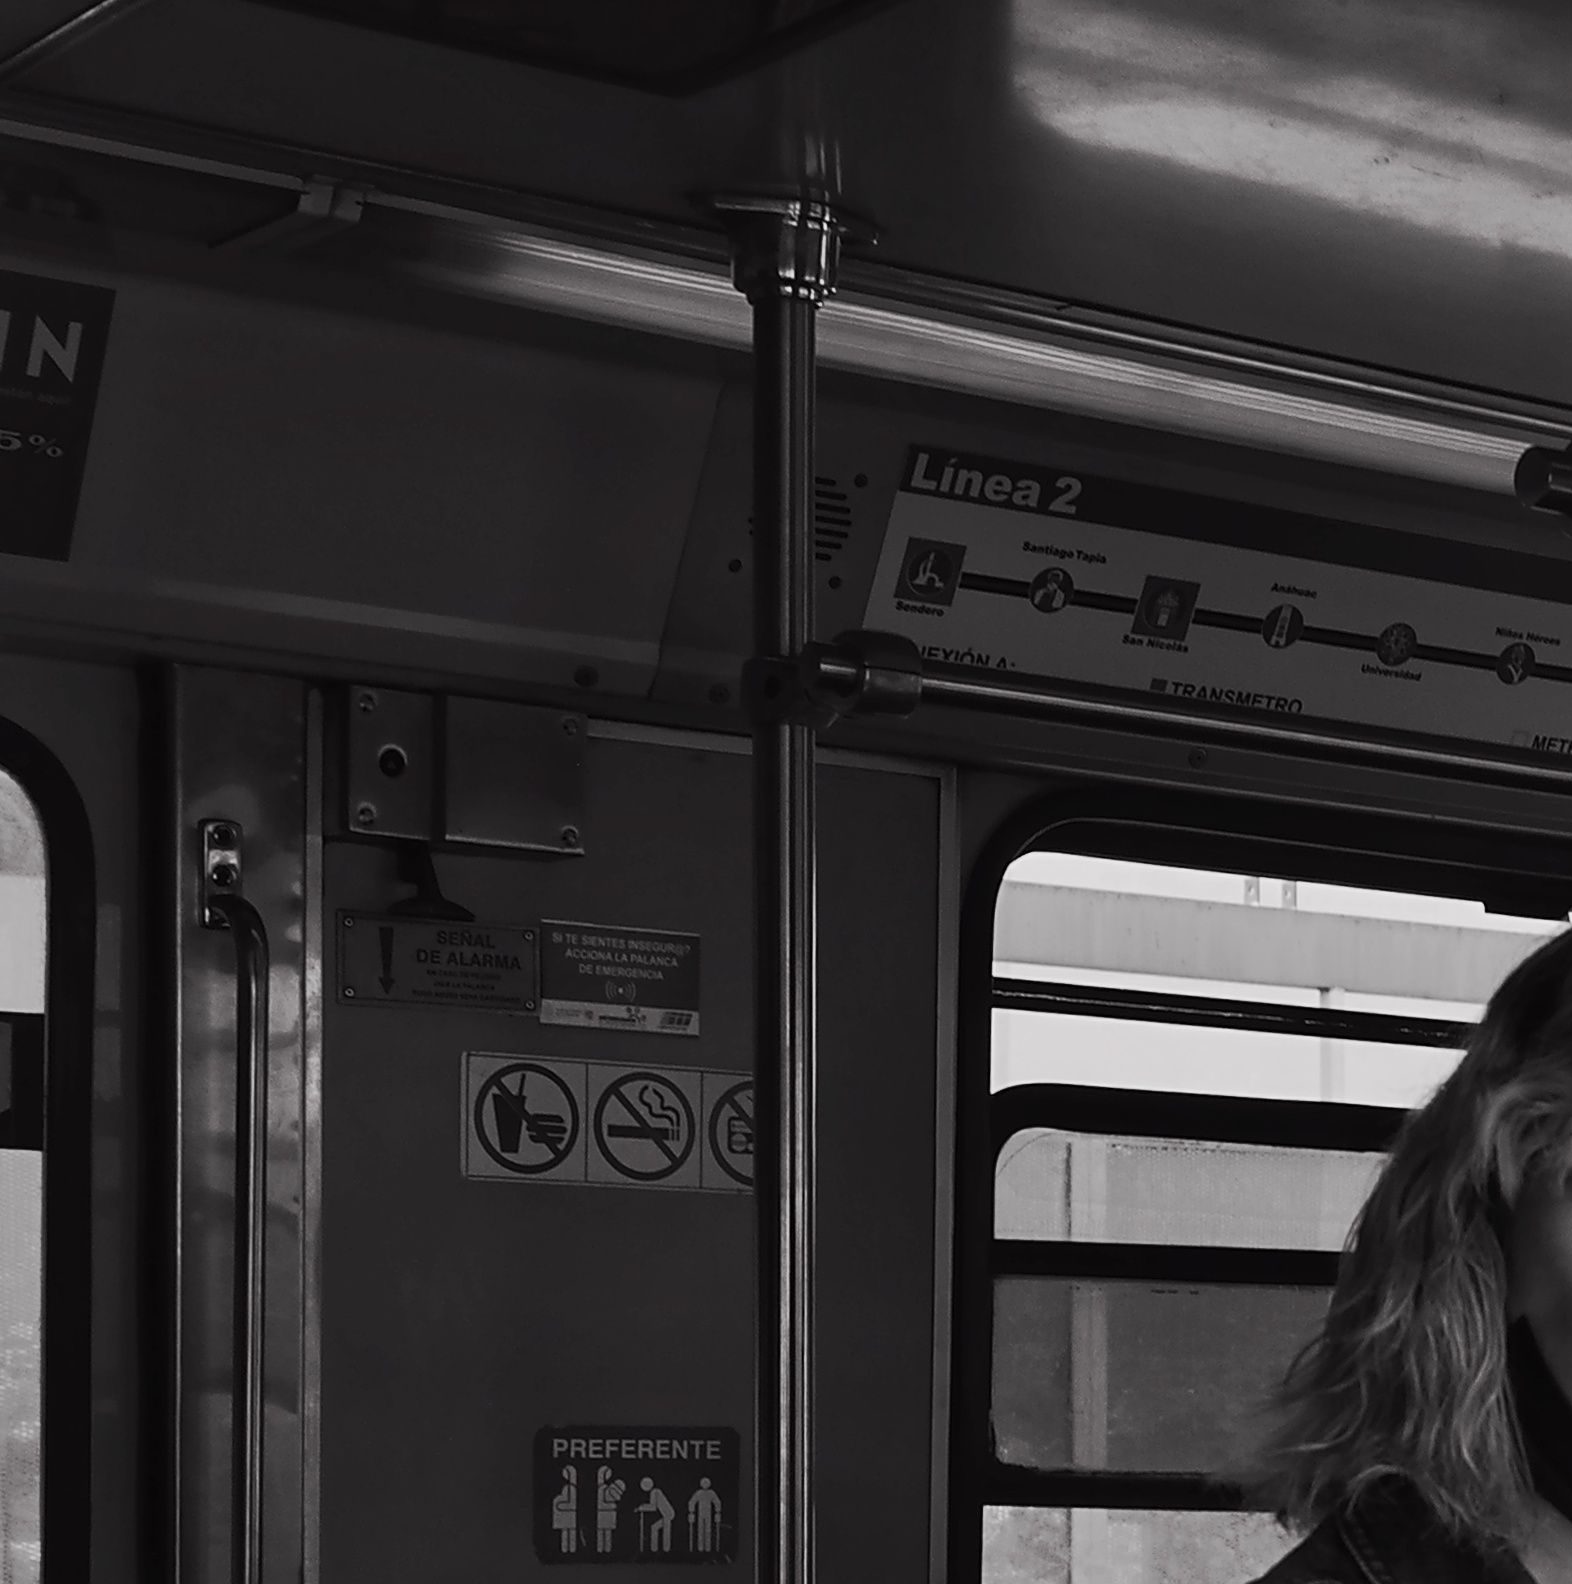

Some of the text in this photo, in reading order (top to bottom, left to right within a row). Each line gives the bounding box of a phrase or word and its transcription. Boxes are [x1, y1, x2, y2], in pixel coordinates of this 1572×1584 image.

[910, 451, 1082, 514] Línea 2
[1022, 541, 1107, 564] Santiago Tapia
[895, 600, 945, 617] Sendero
[1122, 634, 1143, 646] San
[1361, 663, 1422, 682] Universidad
[1171, 681, 1303, 713] TRANSMETRO
[436, 928, 496, 949] SEÑAL
[552, 932, 563, 943] SI
[565, 933, 578, 945] TE
[582, 934, 625, 949] SIENTES
[416, 948, 522, 970] DE ALARMA
[565, 948, 679, 967] ACCIONA LA PALANCA
[578, 963, 664, 980] DE EMERGENCIA
[552, 1438, 721, 1460] PREFERENTE
